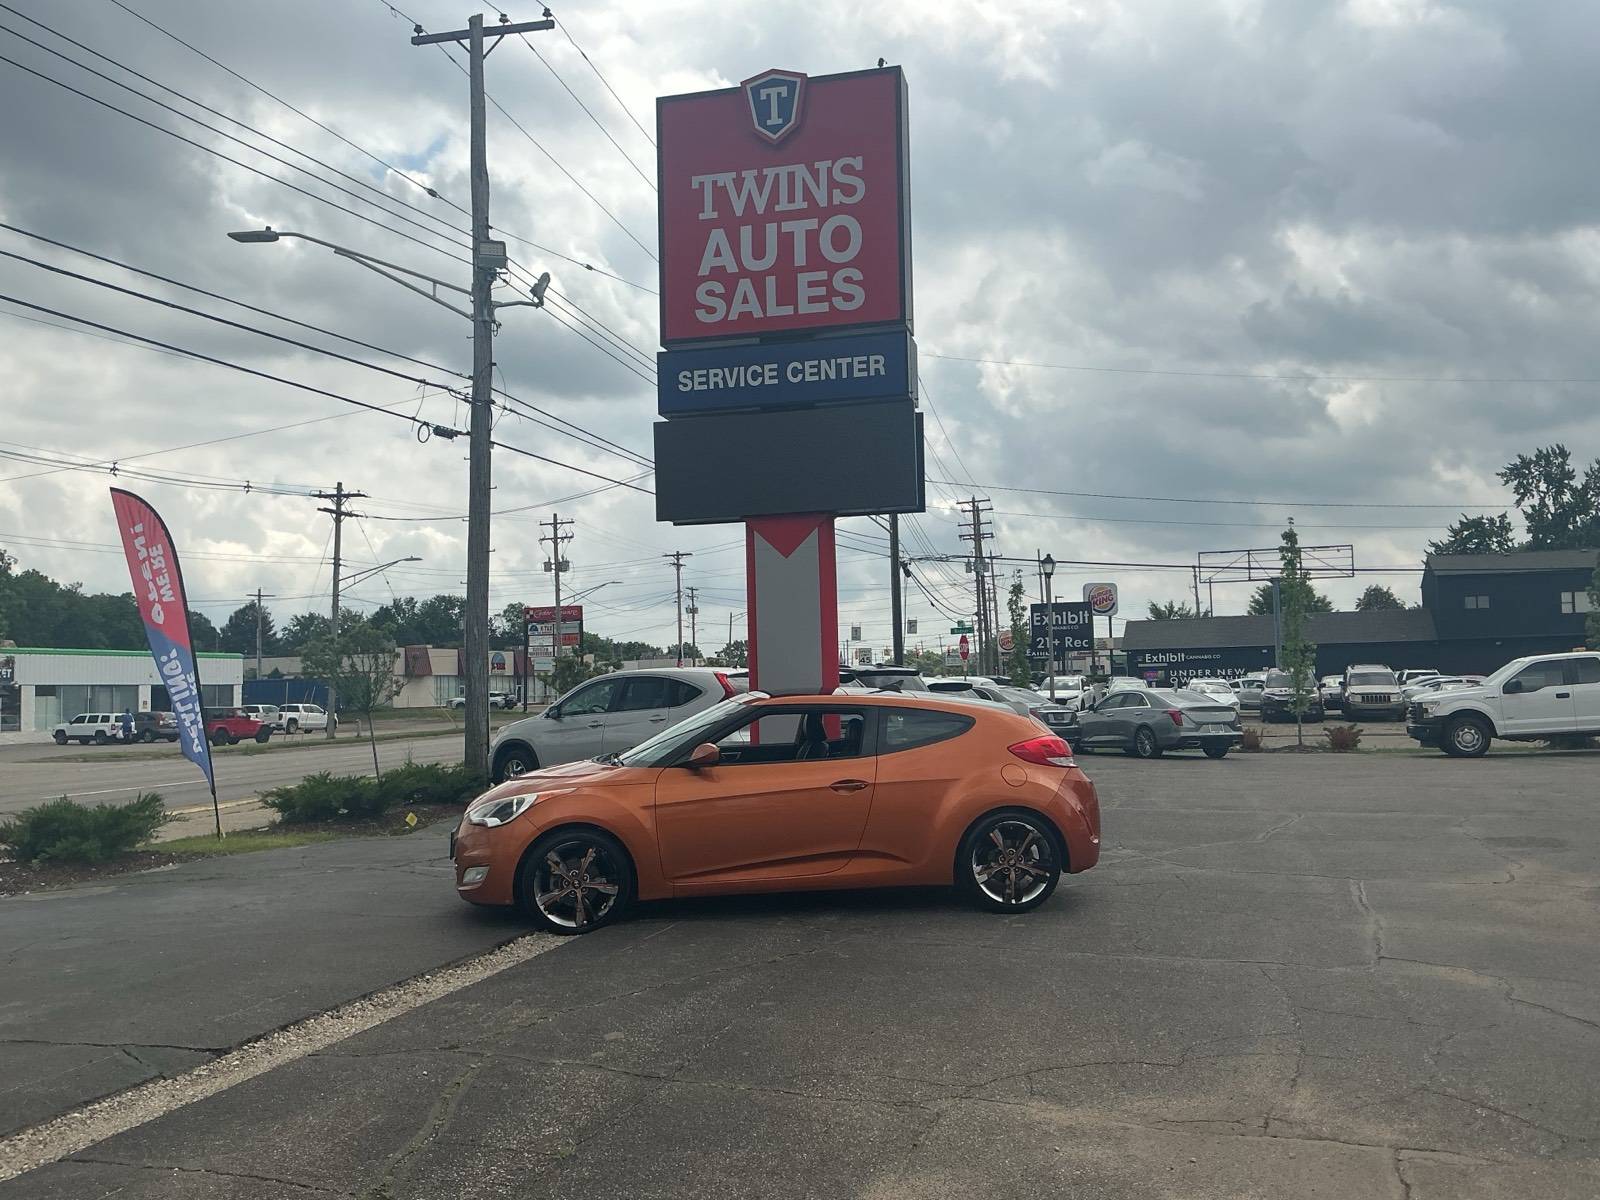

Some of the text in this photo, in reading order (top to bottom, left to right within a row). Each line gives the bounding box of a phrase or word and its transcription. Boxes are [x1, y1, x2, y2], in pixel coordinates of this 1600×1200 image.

[760, 86, 787, 126] T
[691, 156, 865, 219] TWINS
[697, 214, 862, 276] AUTO
[695, 268, 865, 323] SALES
[678, 355, 885, 392] SERVICE CENTER
[1093, 594, 1113, 607] KING
[1033, 610, 1089, 625] Exhibit
[1036, 637, 1060, 649] 21+
[1065, 637, 1089, 647] Rec
[1145, 653, 1185, 662] Exhibit
[1170, 668, 1245, 677] UNDER NEW
